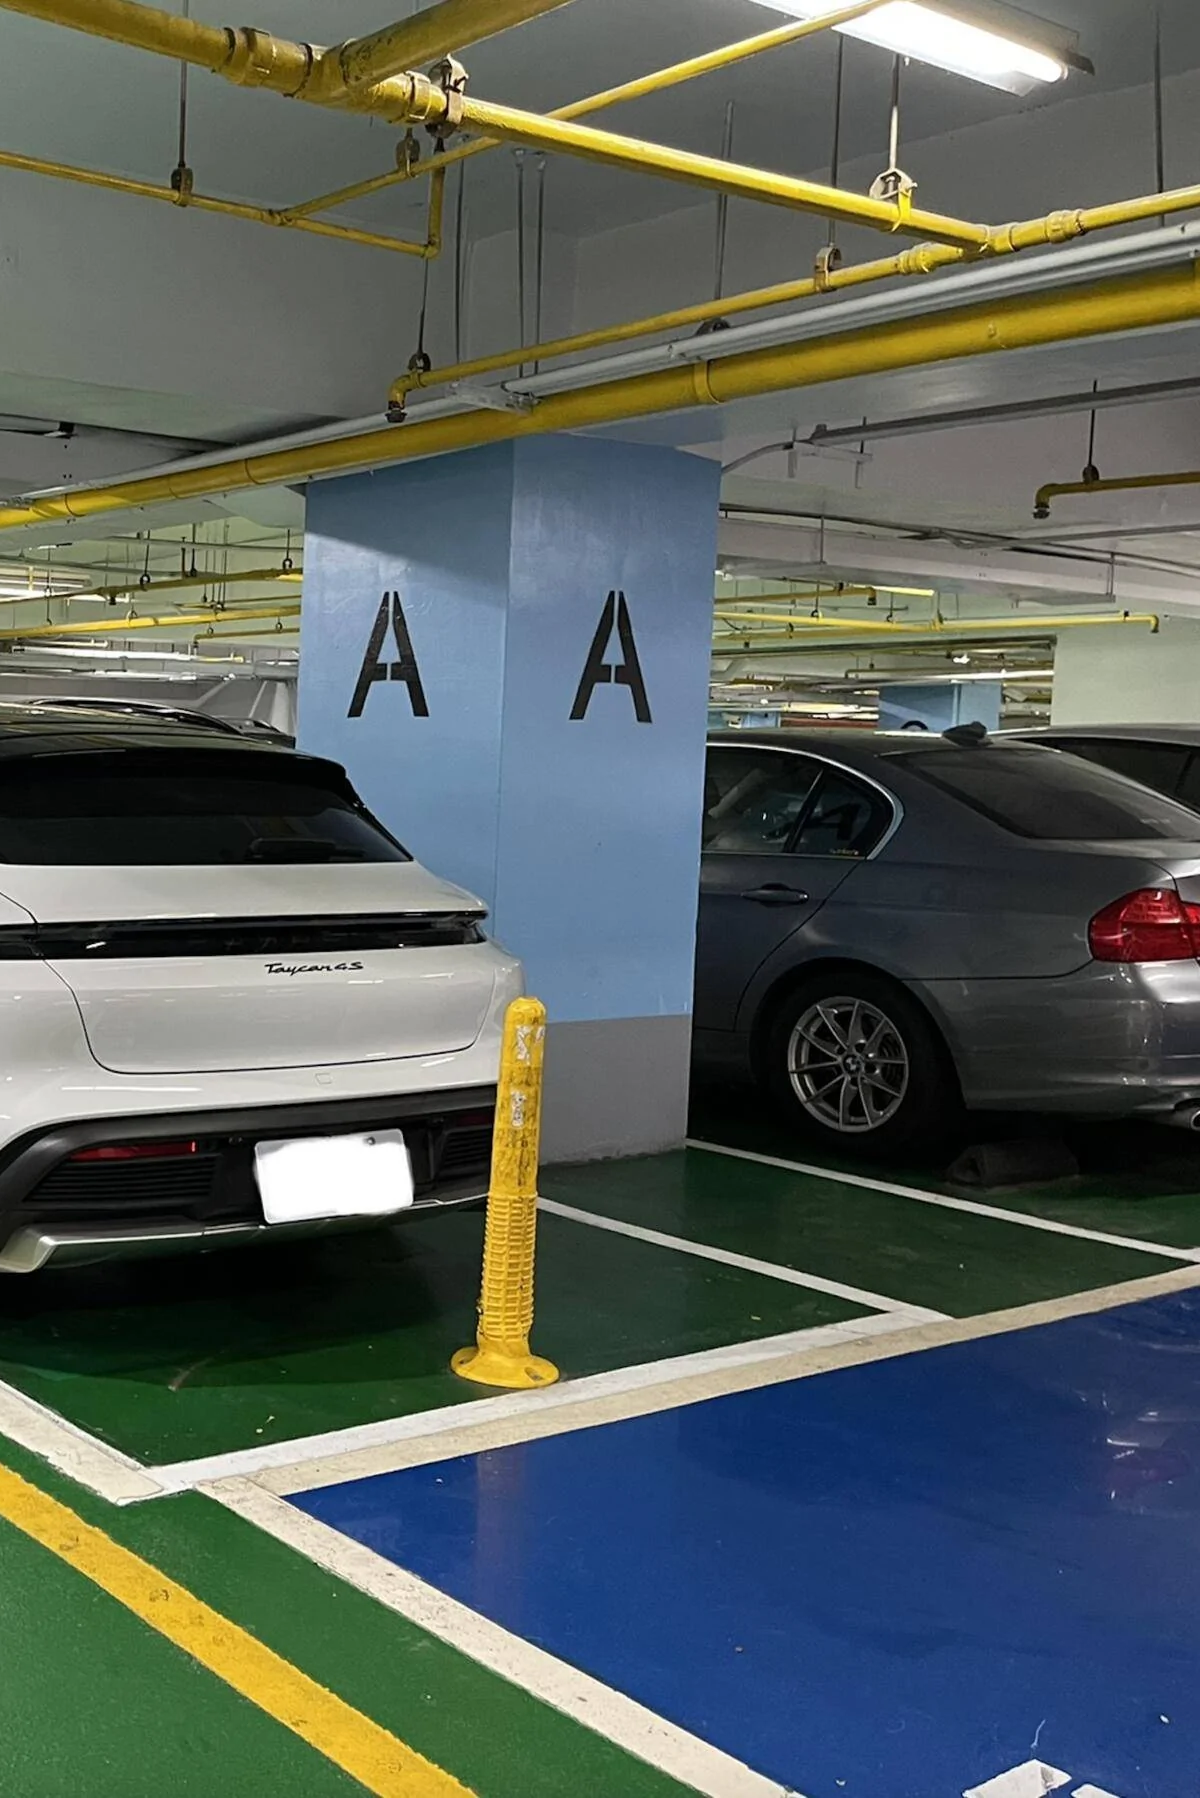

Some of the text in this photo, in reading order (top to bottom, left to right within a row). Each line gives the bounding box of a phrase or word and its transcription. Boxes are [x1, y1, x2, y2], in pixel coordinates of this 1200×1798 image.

[347, 590, 429, 717] A
[569, 590, 652, 723] A
[264, 963, 333, 976] Taycan
